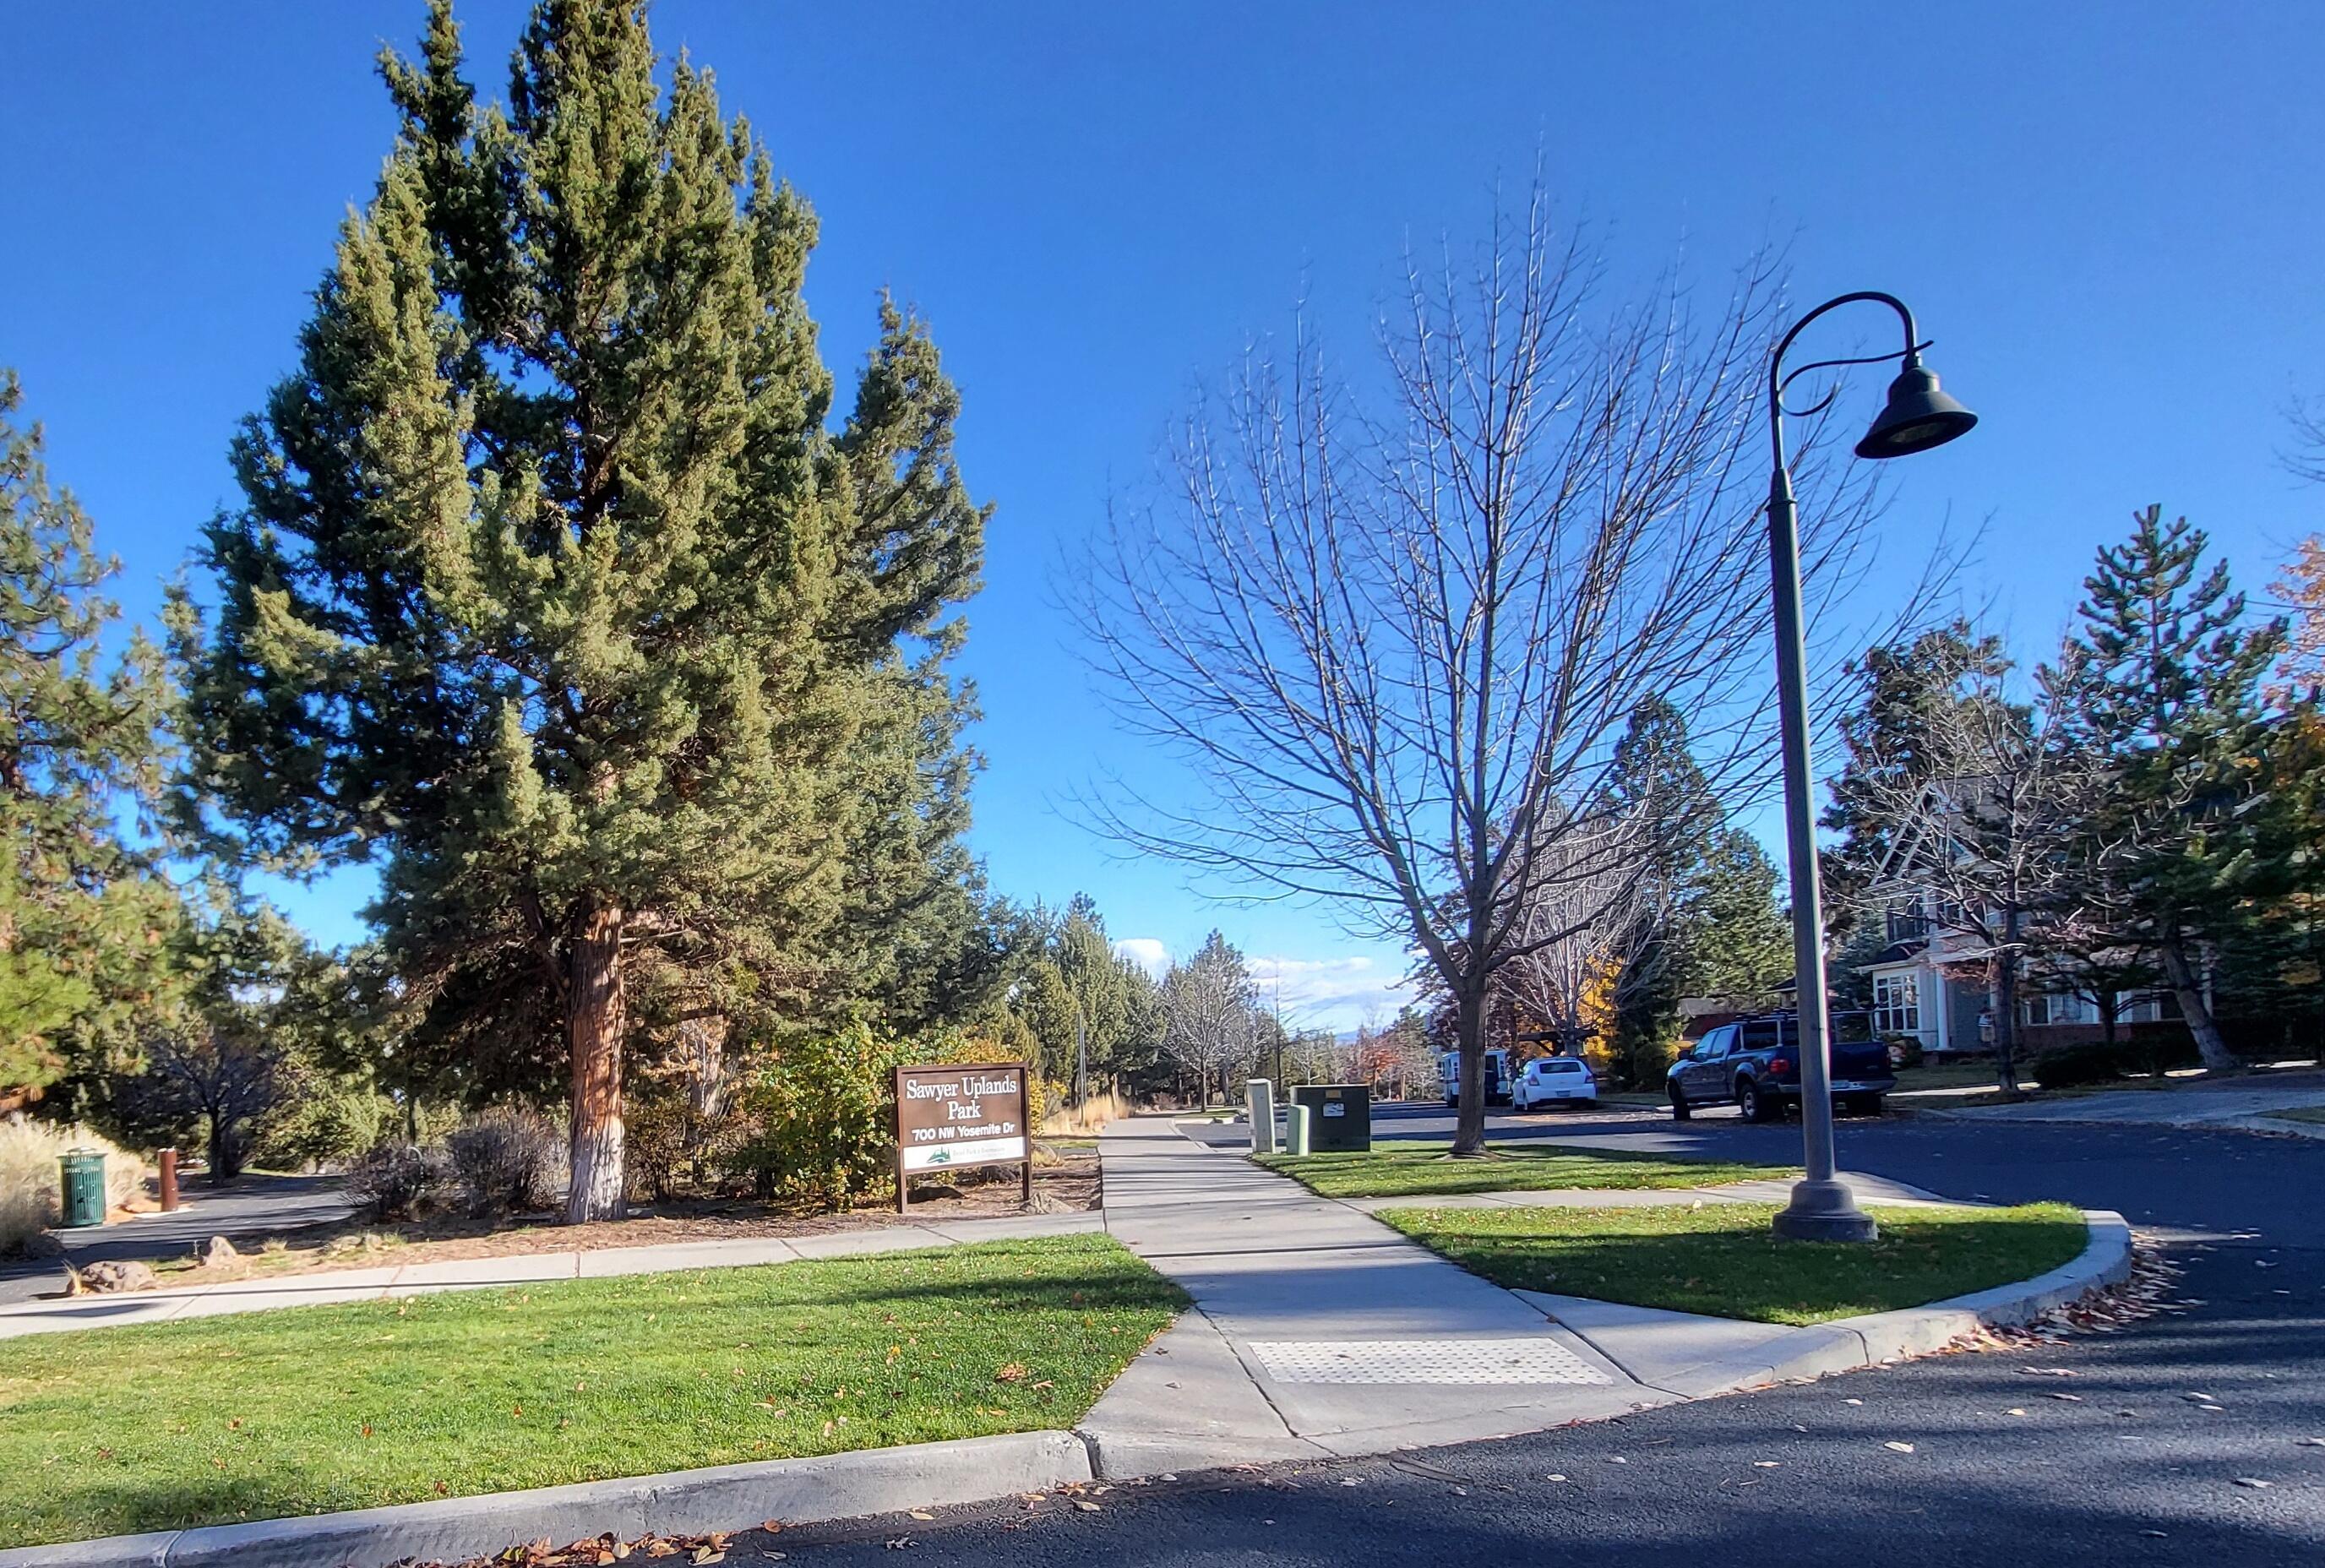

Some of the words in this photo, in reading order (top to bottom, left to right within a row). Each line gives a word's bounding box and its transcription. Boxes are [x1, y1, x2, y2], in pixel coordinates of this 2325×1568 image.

[907, 1079, 959, 1101] Sawyer
[961, 1075, 1016, 1098] Uplands
[947, 1100, 982, 1120] Park
[912, 1129, 935, 1141] 700
[939, 1126, 955, 1139] NW
[957, 1124, 1001, 1137] Yosemite
[1003, 1122, 1015, 1133] Dr
